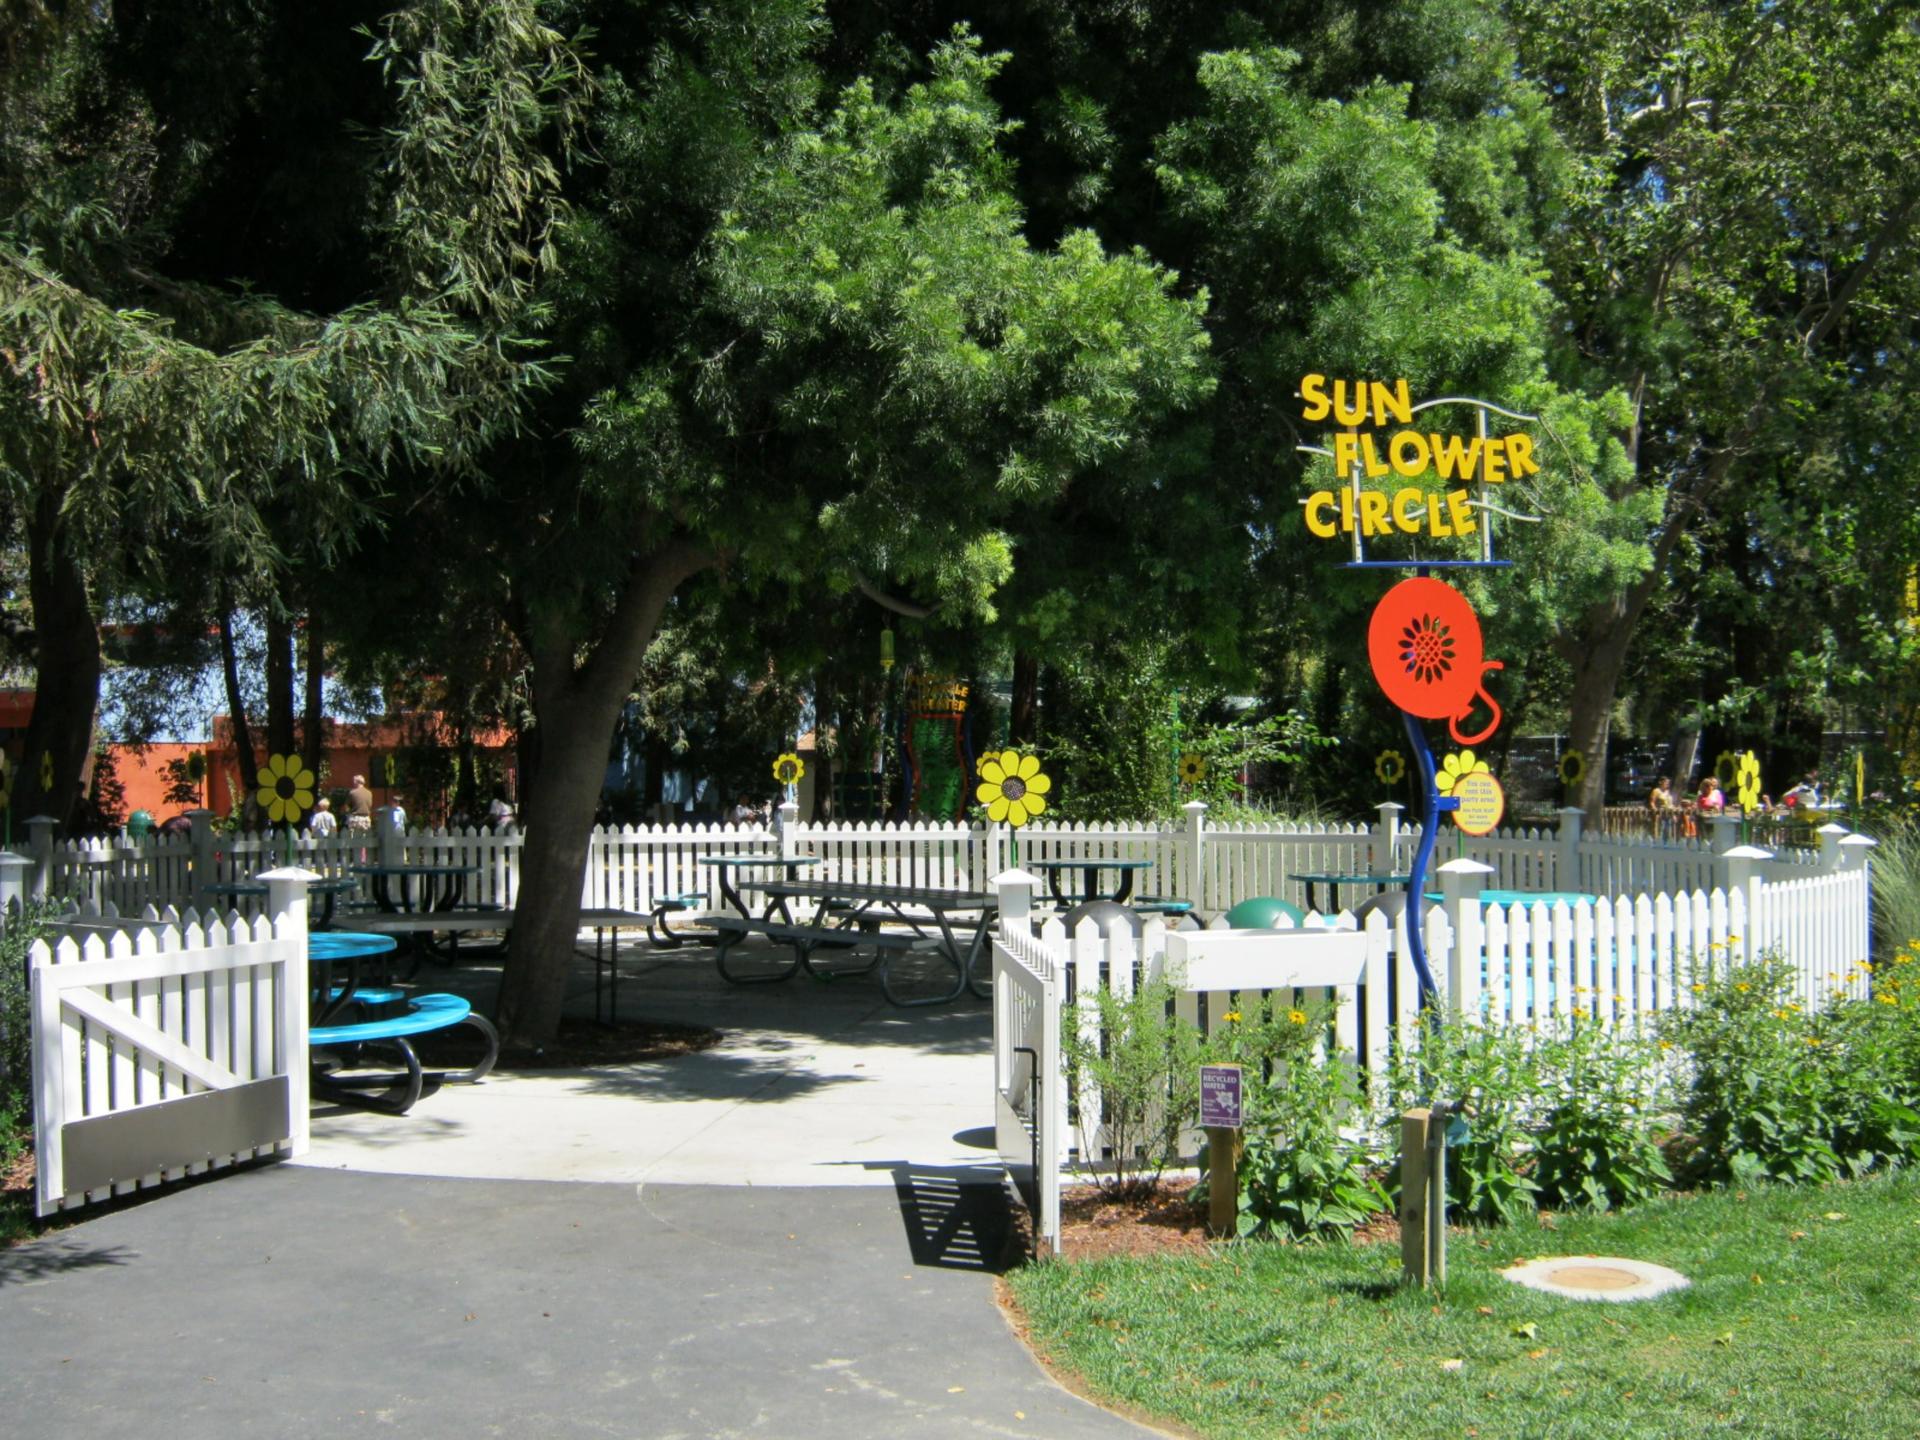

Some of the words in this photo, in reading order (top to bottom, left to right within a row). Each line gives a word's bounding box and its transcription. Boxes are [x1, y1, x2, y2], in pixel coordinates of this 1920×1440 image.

[1301, 373, 1412, 427] SUN
[1335, 430, 1540, 483] FLOWER
[1304, 486, 1477, 538] CIRCLE
[1203, 1075, 1237, 1084] RECYCLED
[1203, 1082, 1226, 1090] WATER
